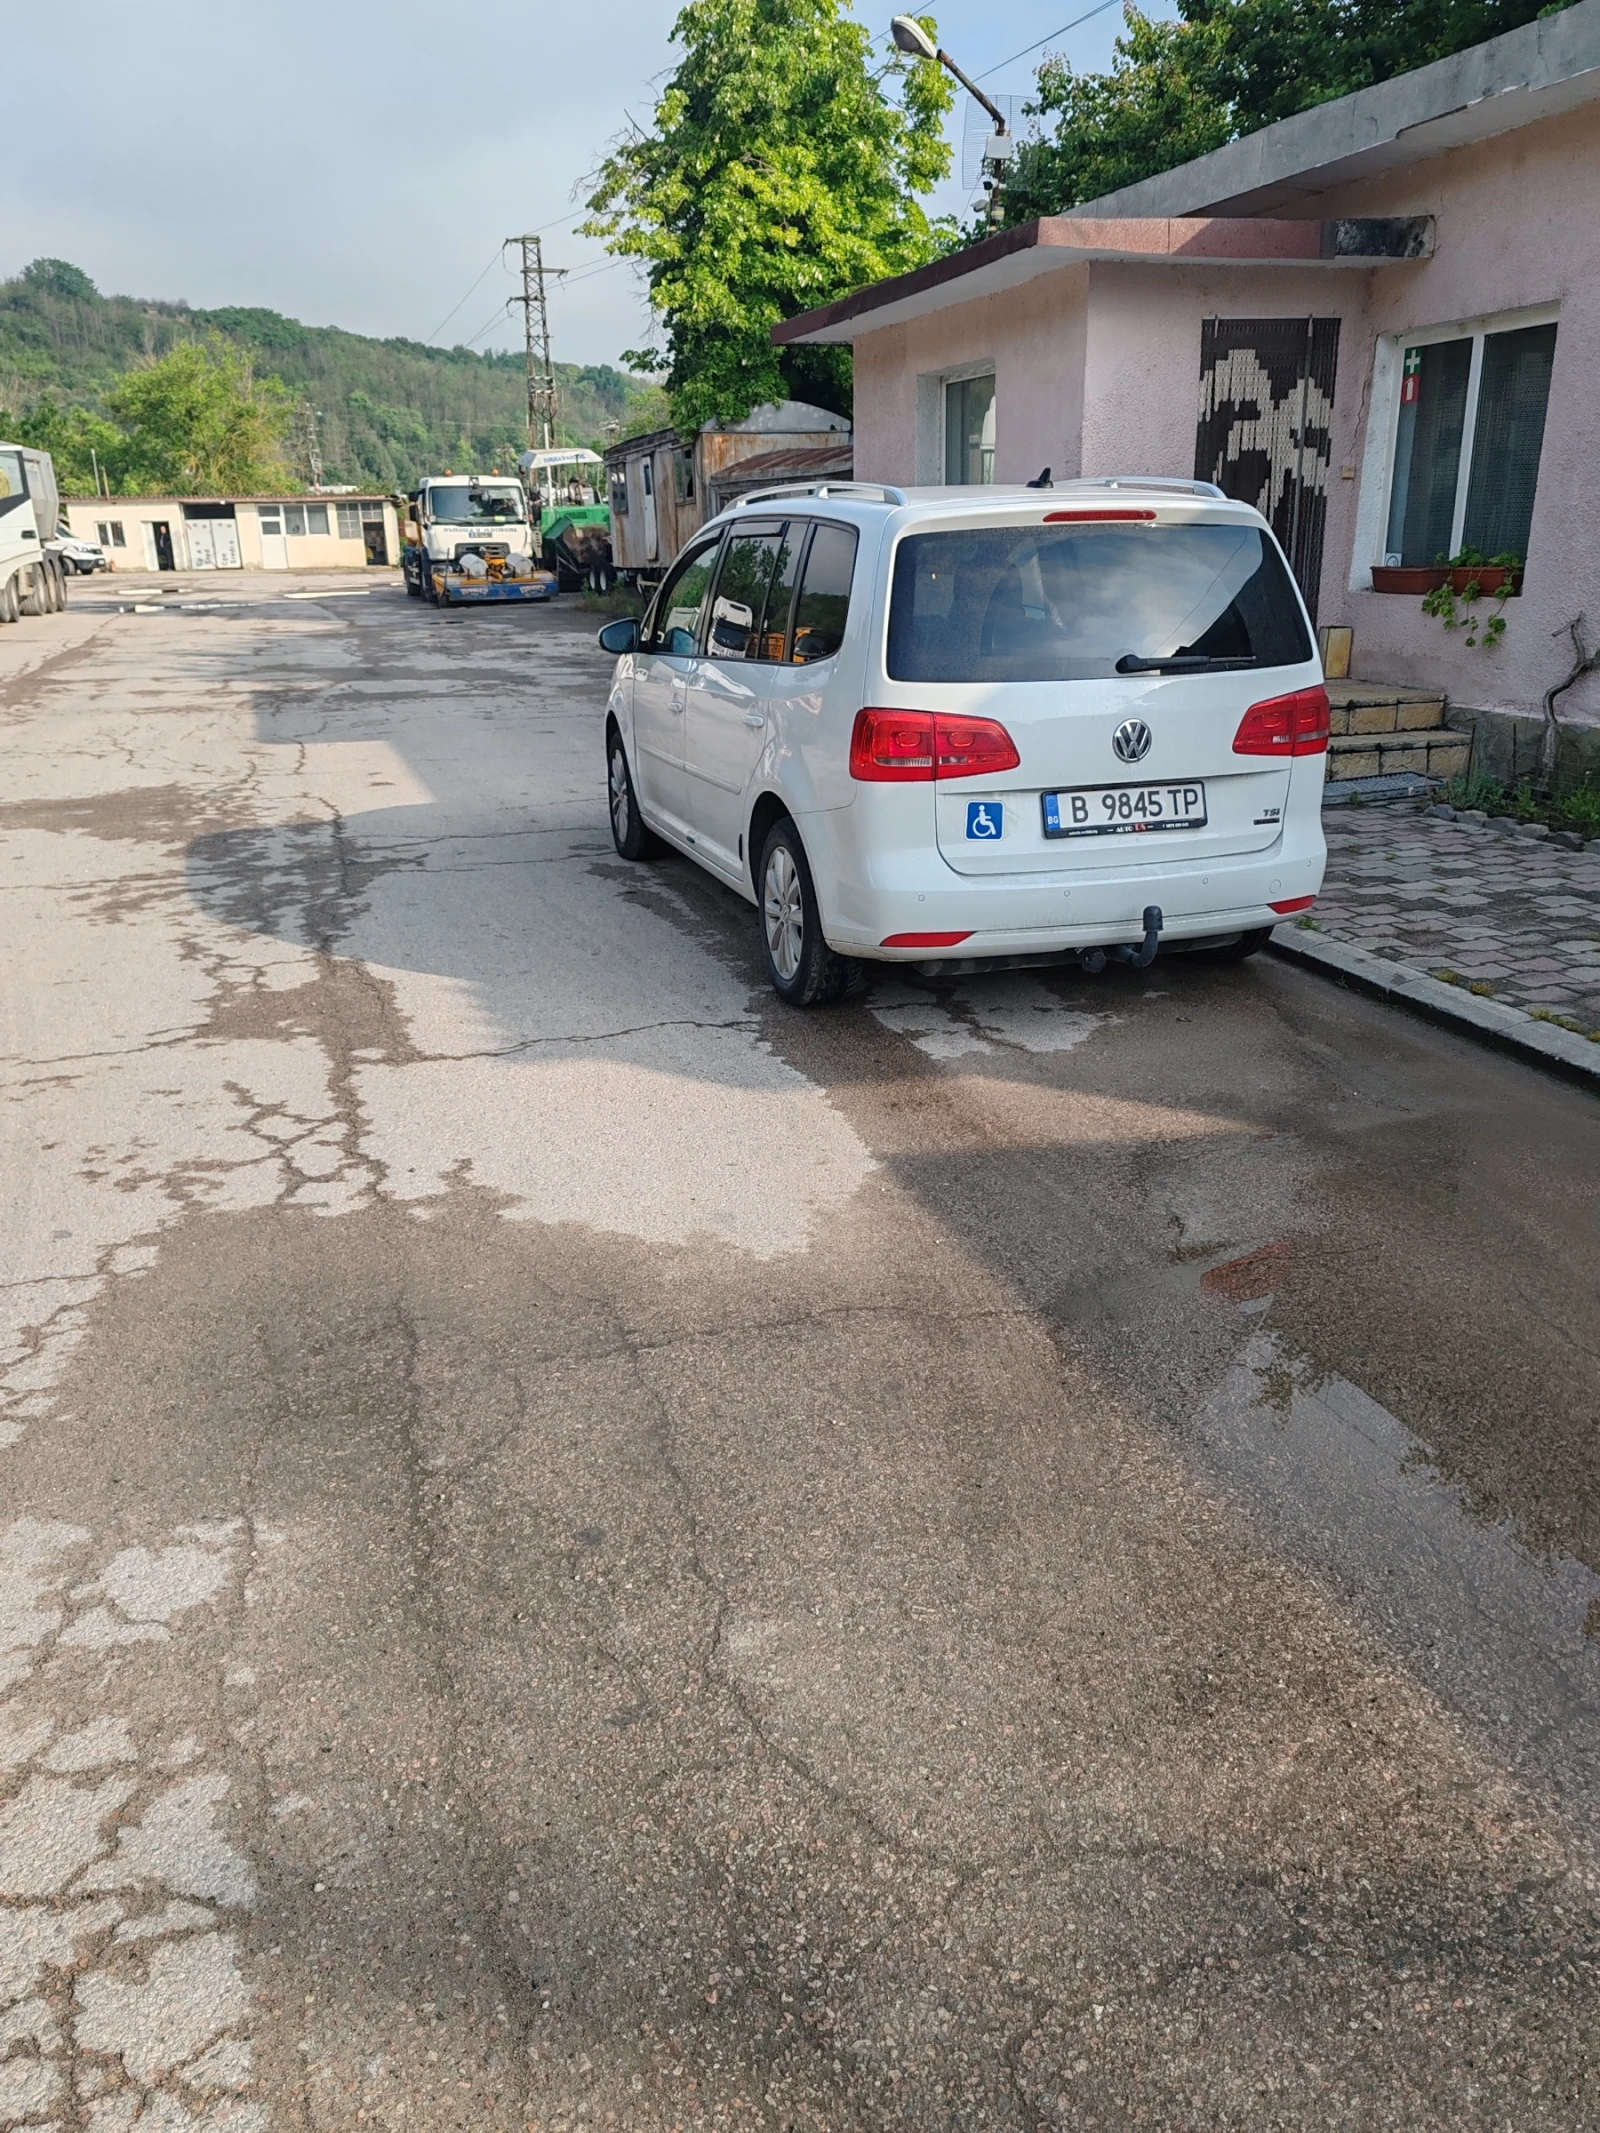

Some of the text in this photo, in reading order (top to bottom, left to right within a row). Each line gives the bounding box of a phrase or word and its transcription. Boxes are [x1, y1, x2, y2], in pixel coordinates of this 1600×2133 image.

[1071, 788, 1199, 824] B 9845 TP
[1263, 808, 1280, 817] TSI
[1047, 815, 1059, 825] BG
